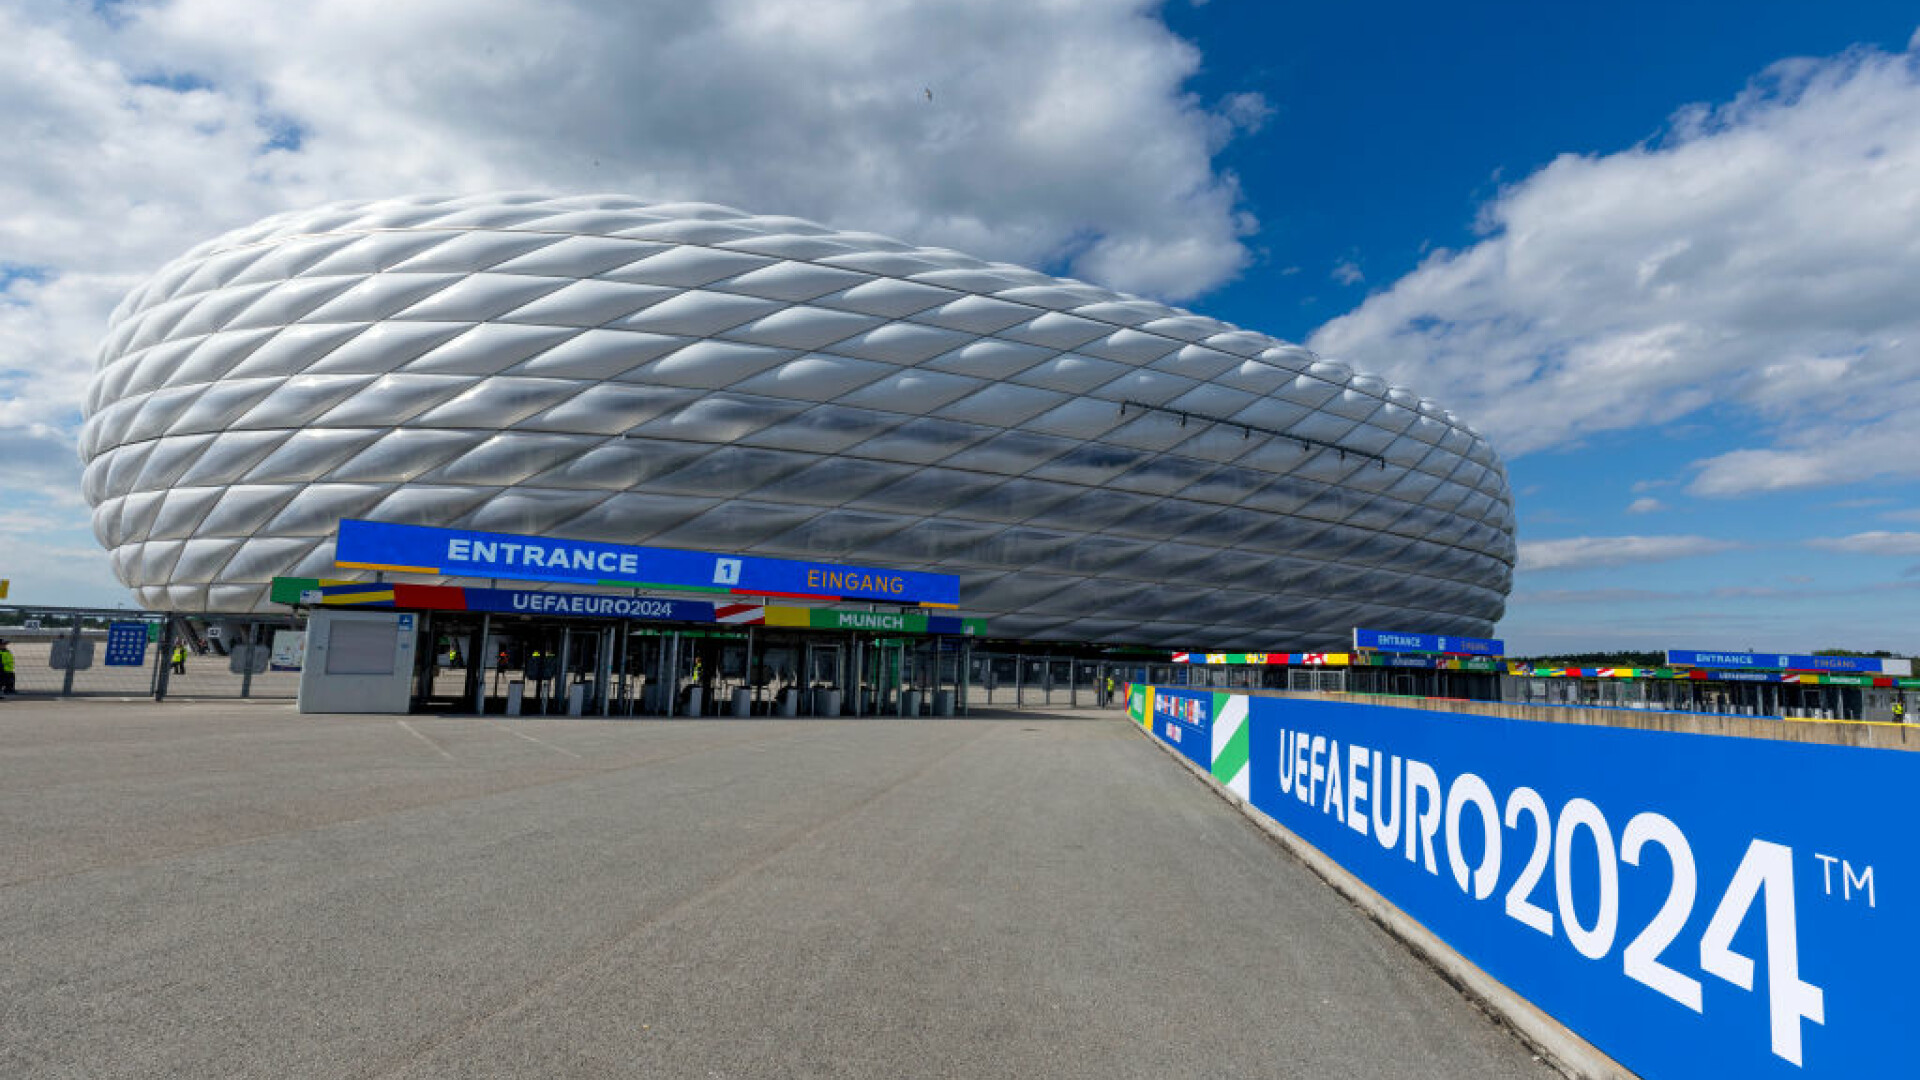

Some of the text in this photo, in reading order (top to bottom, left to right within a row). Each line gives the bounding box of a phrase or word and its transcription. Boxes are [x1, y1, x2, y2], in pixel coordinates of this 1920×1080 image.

[447, 538, 639, 574] ENTRANCE
[807, 569, 904, 593] EINGANG
[839, 612, 904, 630] MUNICH
[1377, 634, 1421, 648] ENTRANCE
[1696, 653, 1754, 664] ENTRANCE
